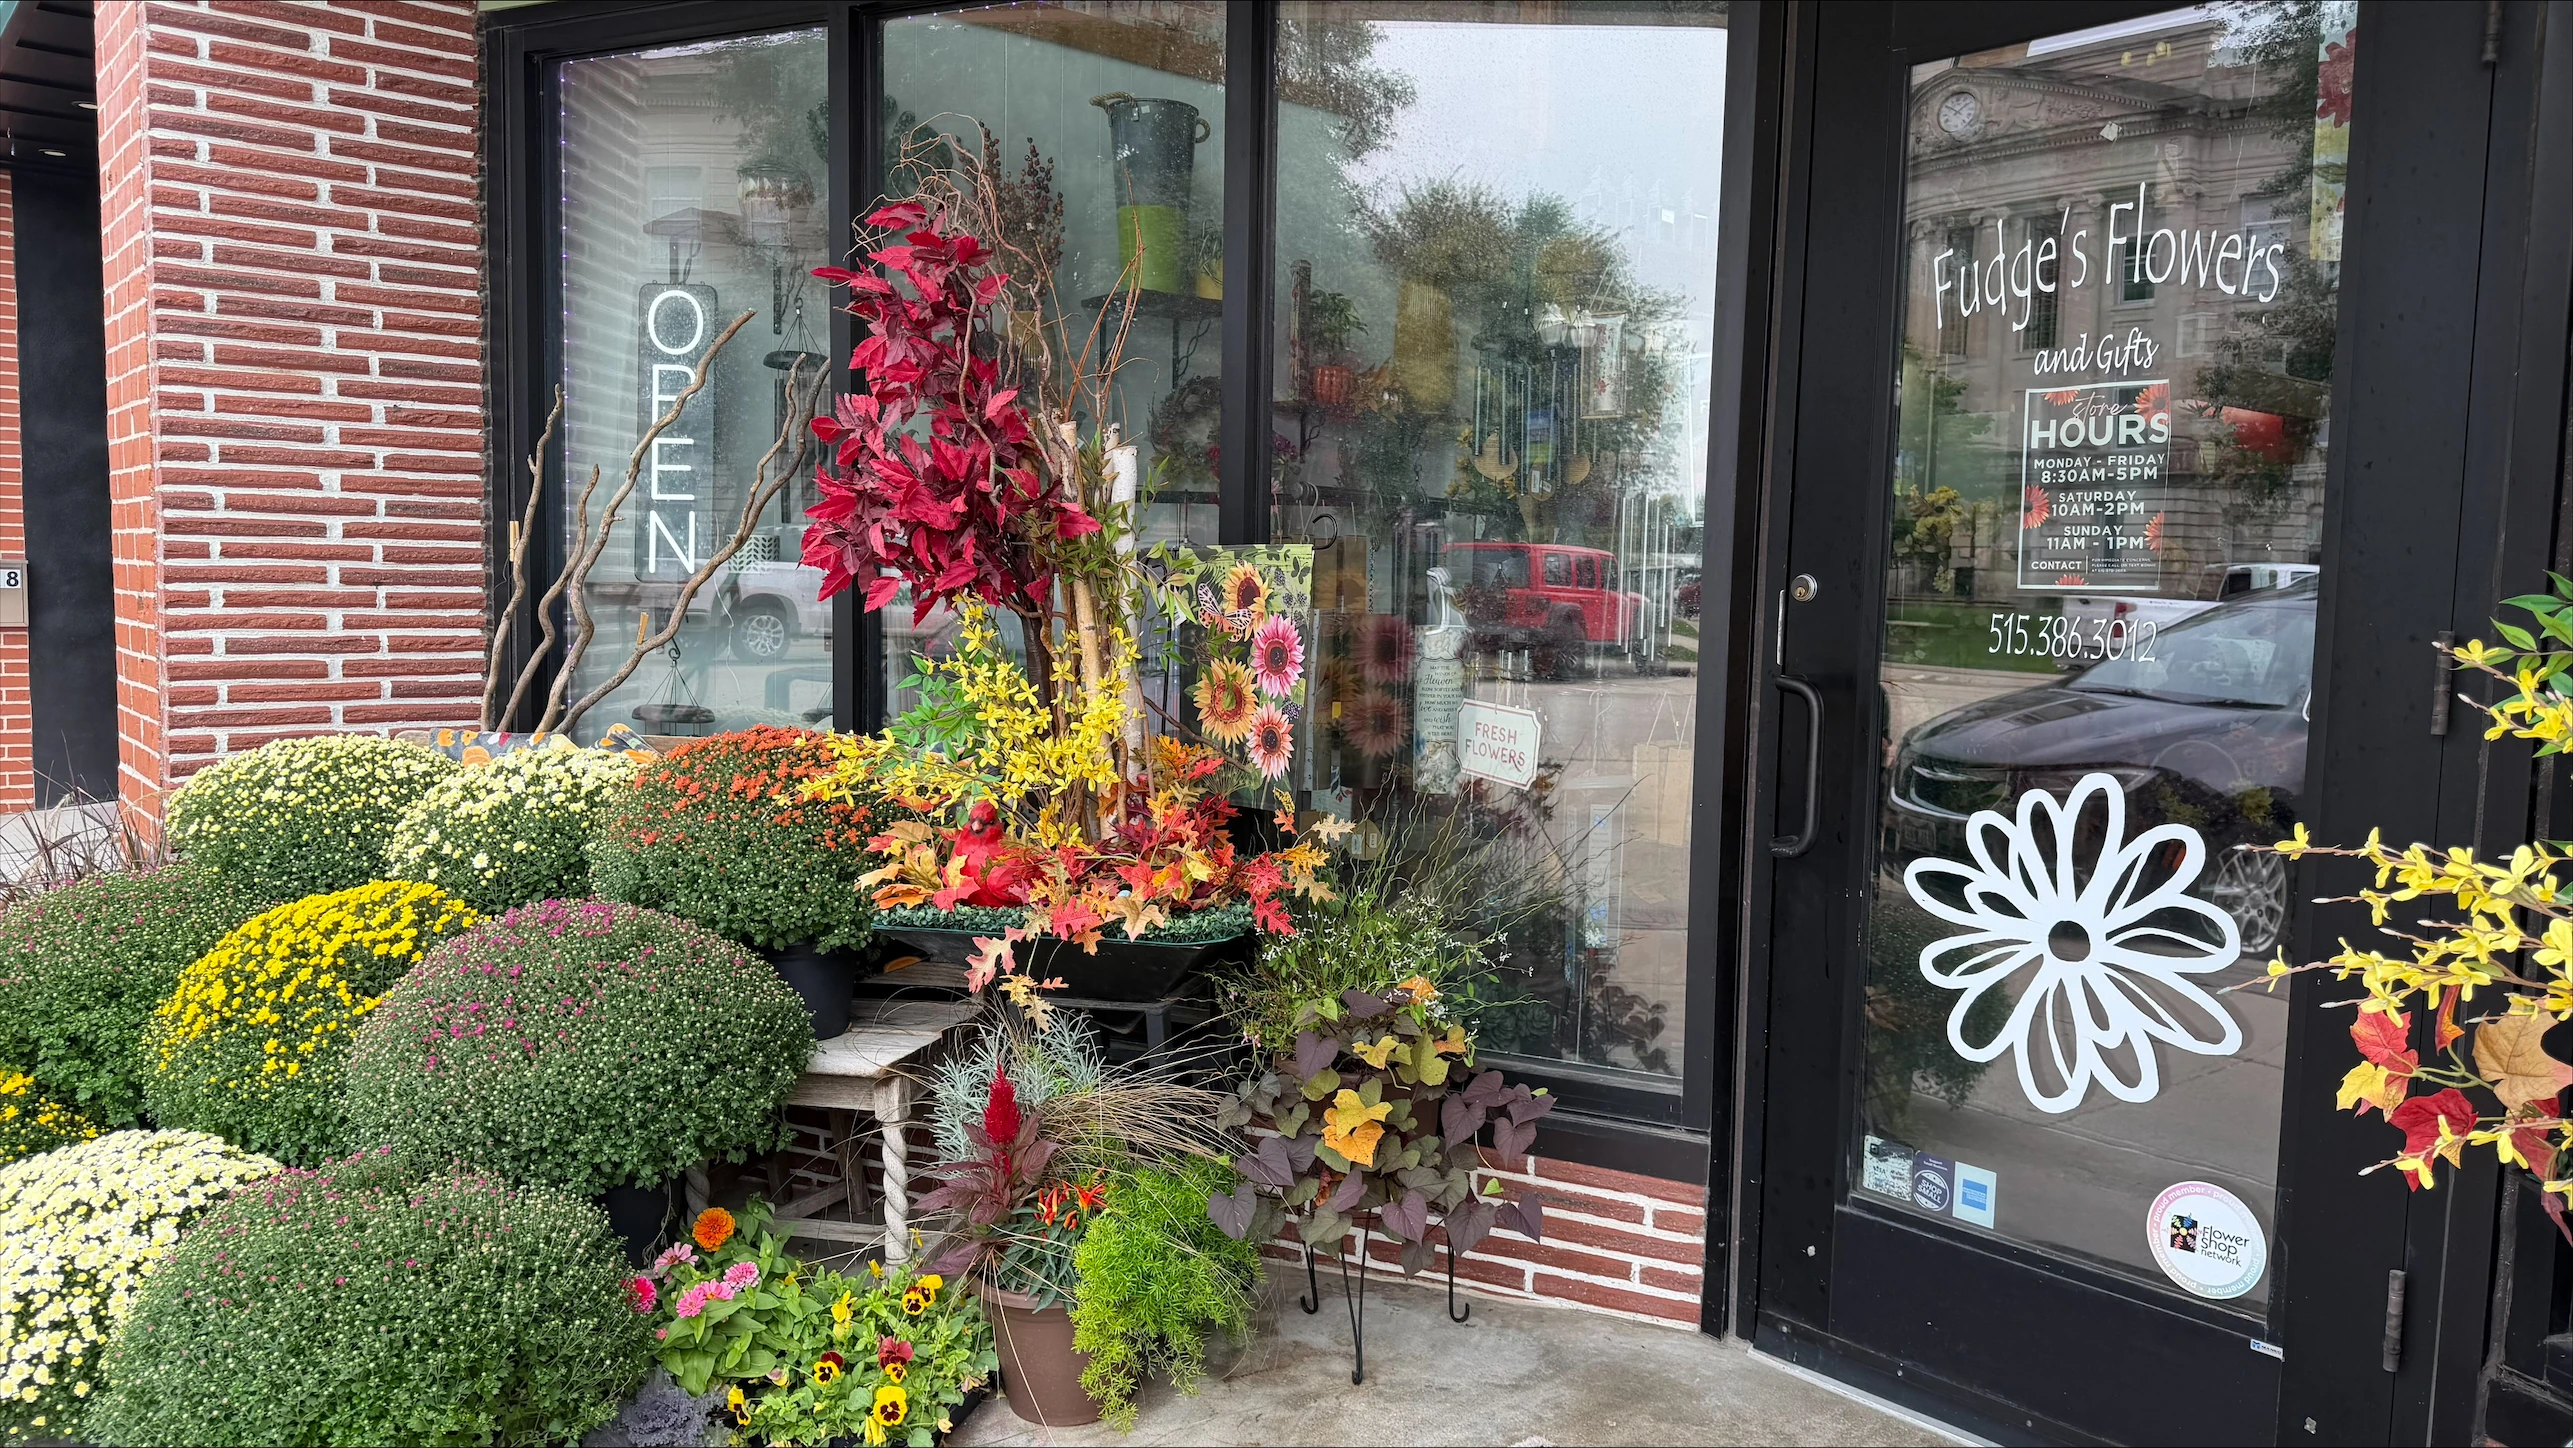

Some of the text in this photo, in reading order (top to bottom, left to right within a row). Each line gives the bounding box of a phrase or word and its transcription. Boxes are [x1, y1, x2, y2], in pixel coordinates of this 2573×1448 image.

[1933, 181, 2285, 332] Fudge's Flowers
[2034, 326, 2160, 376] and Gifts
[2072, 391, 2128, 422] store
[648, 290, 703, 574] OPEN
[2030, 412, 2170, 449] HOURS
[2034, 456, 2092, 469] MONDAY
[2107, 453, 2166, 466] FRIDAY
[2041, 466, 2158, 483] 8:30AM-5PM
[2059, 490, 2137, 502] SATURDAY
[2052, 502, 2145, 516] 10AM-2PM
[2064, 525, 2123, 536] SUNDAY
[2047, 537, 2086, 550] 11AM
[2107, 536, 2144, 550] 1PM
[2031, 561, 2083, 570] CONTACT
[6, 571, 19, 587] 8
[1988, 612, 2158, 663] 515.386.3012
[1475, 721, 1517, 745] FRESH
[1465, 738, 1526, 773] FLOWERS
[1917, 1184, 1942, 1204] SMALL
[1920, 1179, 1943, 1195] SHOP
[2153, 1185, 2206, 1223] proud member
[2201, 1236, 2238, 1258] Shop
[2202, 1225, 2250, 1248] Flower
[2152, 1227, 2198, 1289] proud member
[2200, 1249, 2242, 1268] network
[2207, 1257, 2260, 1296] proud member
